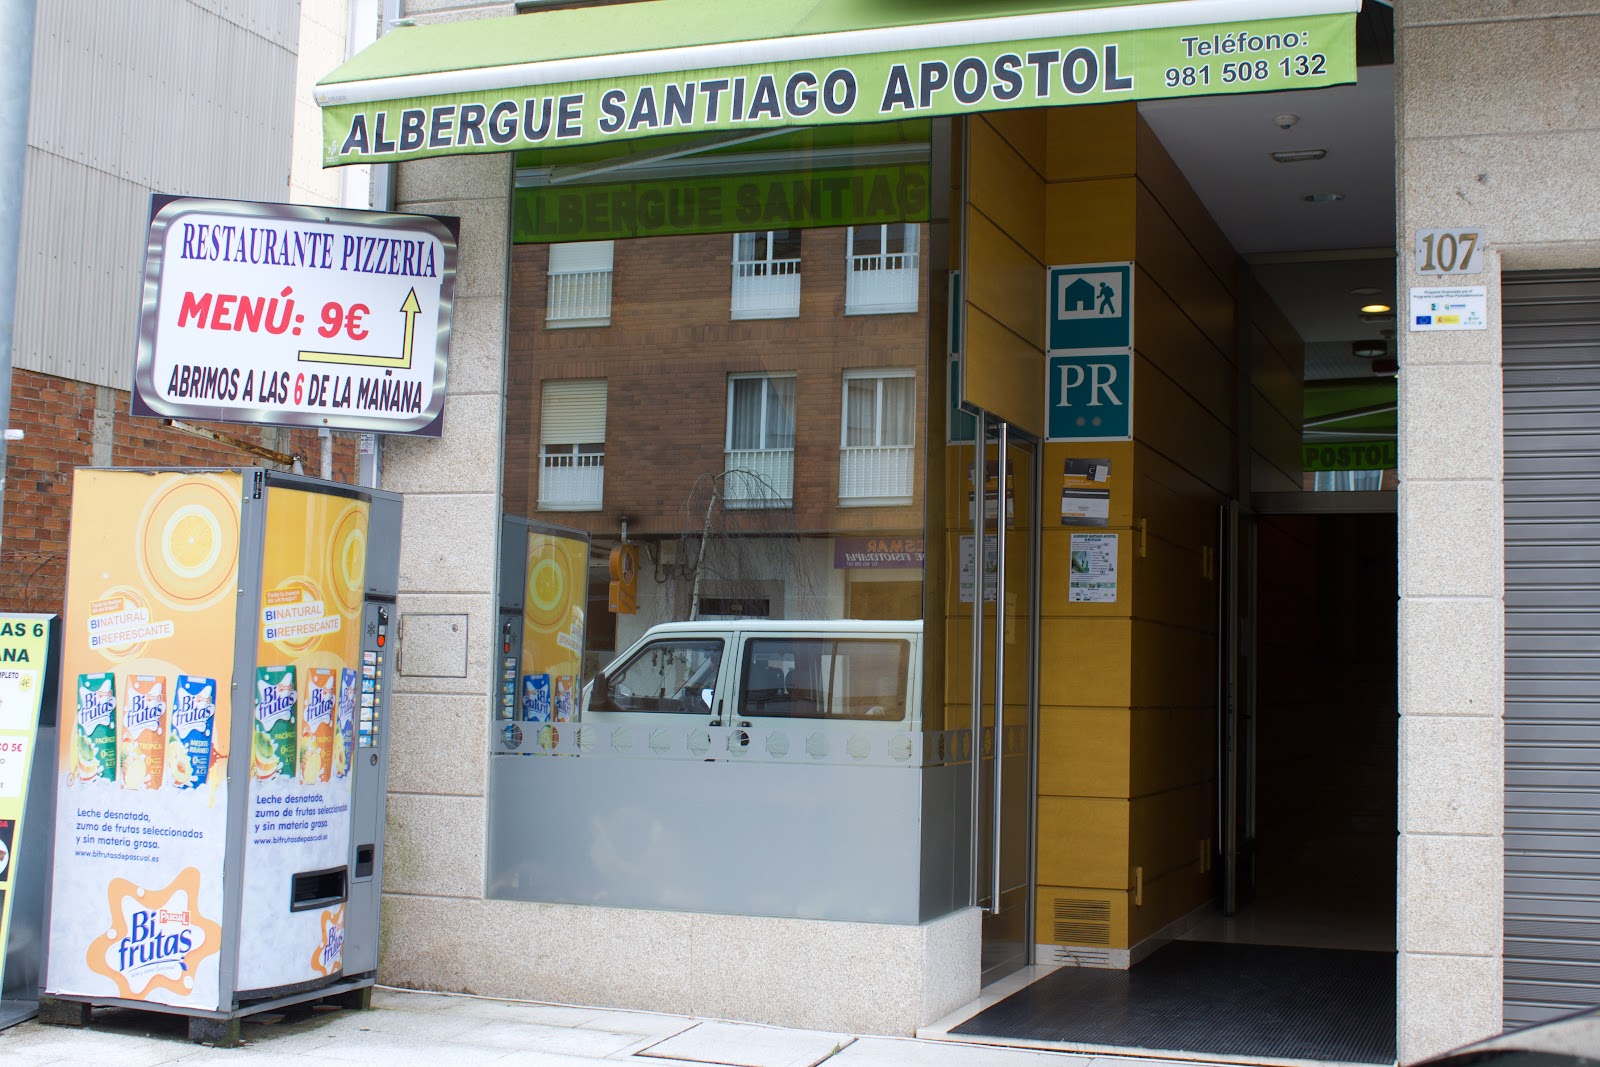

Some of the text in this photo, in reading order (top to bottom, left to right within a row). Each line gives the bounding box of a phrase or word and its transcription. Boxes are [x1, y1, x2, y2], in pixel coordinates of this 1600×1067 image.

[1181, 28, 1309, 58] Teléfono:
[1165, 53, 1327, 88] 981 508 132
[339, 44, 1134, 156] ALBERGUE SANTIAGO APOSTOL
[180, 223, 437, 278] RESTAURANTE PIZZERIA
[1420, 233, 1478, 272] 107
[177, 286, 371, 341] MENÚ: 9€
[167, 364, 422, 413] ABRIMOS A LAS 6 DE LA MAÑANA
[1056, 363, 1123, 407] PR
[91, 612, 146, 629] BINATURAL
[265, 605, 322, 620] BINATURAL
[33, 623, 43, 637] 6
[92, 624, 170, 646] BIREFRESCANTE
[266, 618, 338, 639] BIREFRESCANTE
[20, 679, 30, 687] 4€
[85, 692, 96, 710] Bi
[132, 695, 145, 713] Bi
[183, 695, 195, 713] Bi
[264, 686, 277, 704] Bi
[312, 688, 323, 706] Bi
[81, 698, 113, 724] frutas
[128, 703, 162, 727] frutas
[259, 693, 294, 720] frutas
[176, 705, 211, 727] frutas
[11, 743, 22, 752] 5€
[256, 793, 324, 804] Leche desnatada,
[77, 808, 151, 823] Leche desnatada,
[282, 808, 293, 817] de
[296, 807, 316, 816] frutas
[317, 804, 348, 815] seleccionadas
[76, 822, 204, 839] zumo de frutas seleccionadas
[255, 820, 328, 833] y sin materia grasa.
[75, 834, 160, 850] y sin materia grasa.
[254, 834, 328, 844] www.bifrutasdepascual.es
[74, 850, 160, 862] www.bifrutasdepascual.es
[132, 910, 157, 944] Bi
[118, 929, 192, 972] frutas
